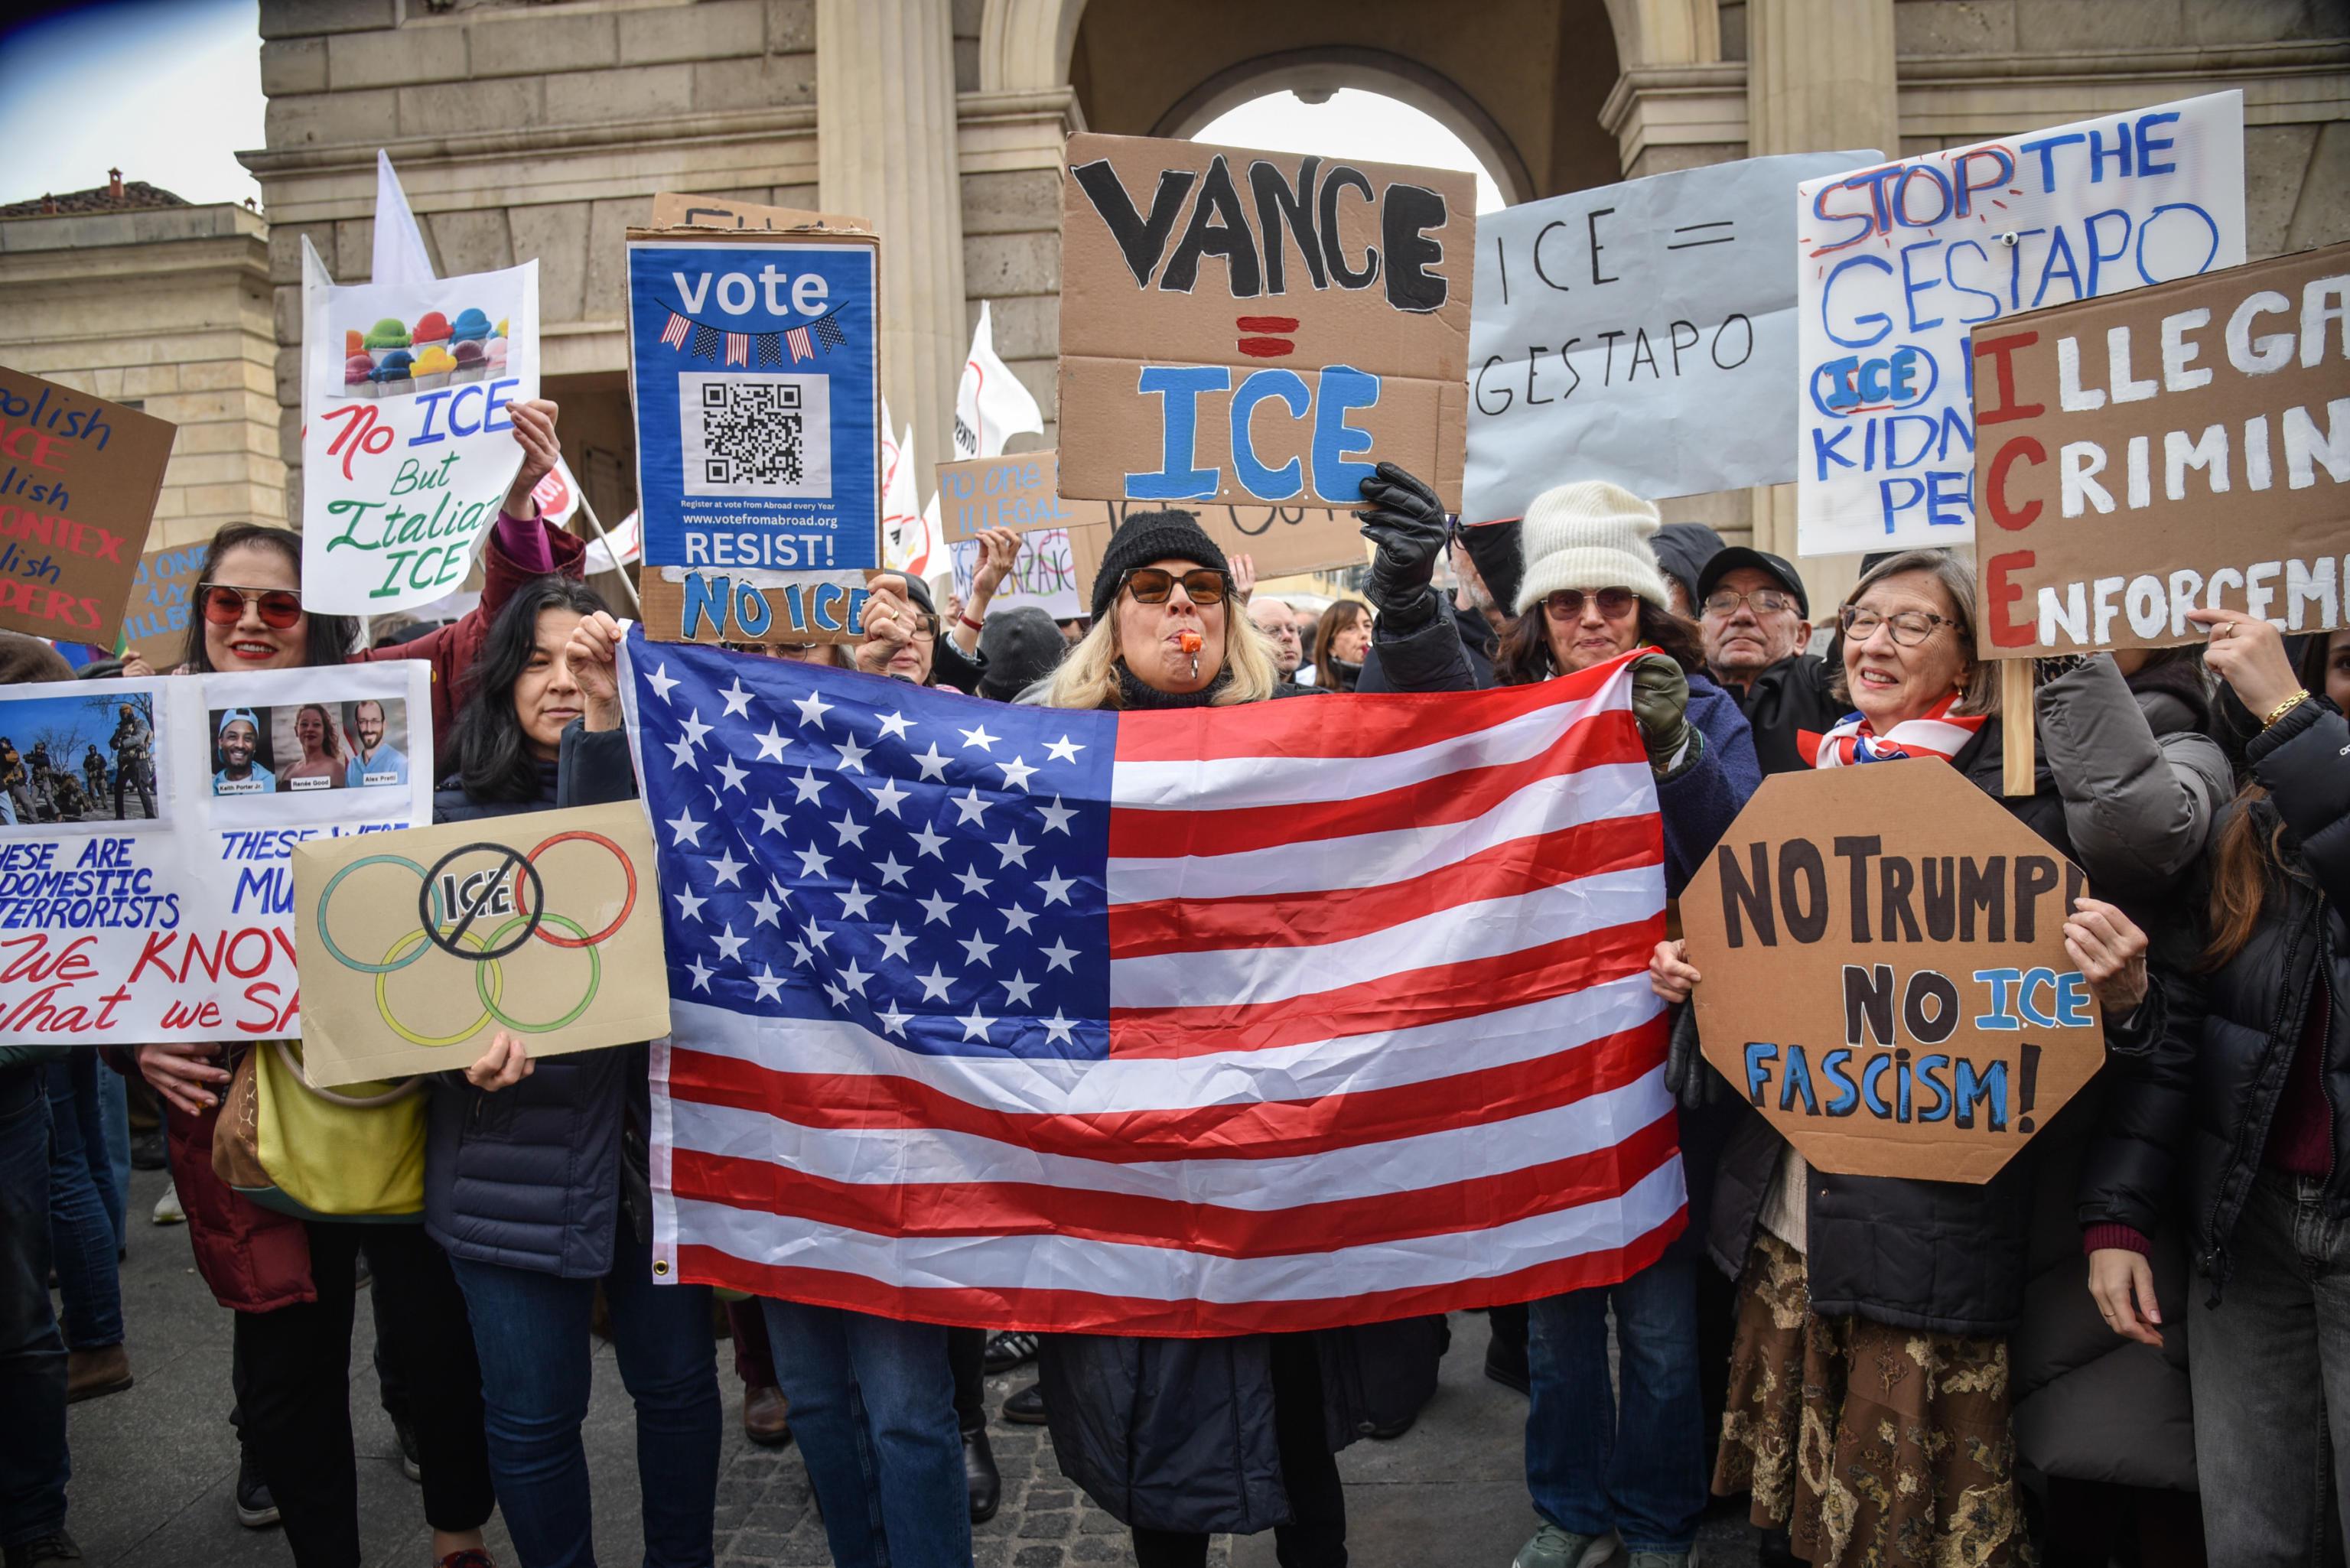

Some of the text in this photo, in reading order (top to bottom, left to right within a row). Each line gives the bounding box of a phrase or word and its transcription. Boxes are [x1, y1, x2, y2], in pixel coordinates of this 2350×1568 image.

[1810, 112, 2180, 257] STOP THE
[1069, 154, 1448, 313] VANCE
[1498, 207, 1619, 305] ICE
[672, 265, 829, 316] vote
[1821, 203, 2218, 348] GESTAPO
[1476, 314, 1753, 416] GESTAPO
[408, 379, 519, 447] ICE
[389, 451, 461, 496] But
[681, 500, 712, 509] Register
[794, 503, 816, 511] every
[683, 514, 838, 529] www.votefromabroad.org
[959, 496, 1075, 534] ILLEGAL
[1880, 468, 1975, 535] PE
[369, 539, 470, 599] ICE
[685, 532, 835, 566] RESIST!
[682, 568, 871, 641] NO ICE
[1988, 554, 2350, 648] ENFORCEM
[313, 779, 329, 787] Good
[380, 774, 396, 782] Pretti
[76, 838, 135, 869] ARE
[1, 868, 153, 897] DOMESTIC
[1717, 838, 1829, 948] NO
[0, 893, 180, 929] TERRORISTS
[160, 1000, 223, 1029] we
[1841, 963, 1959, 1047] NO
